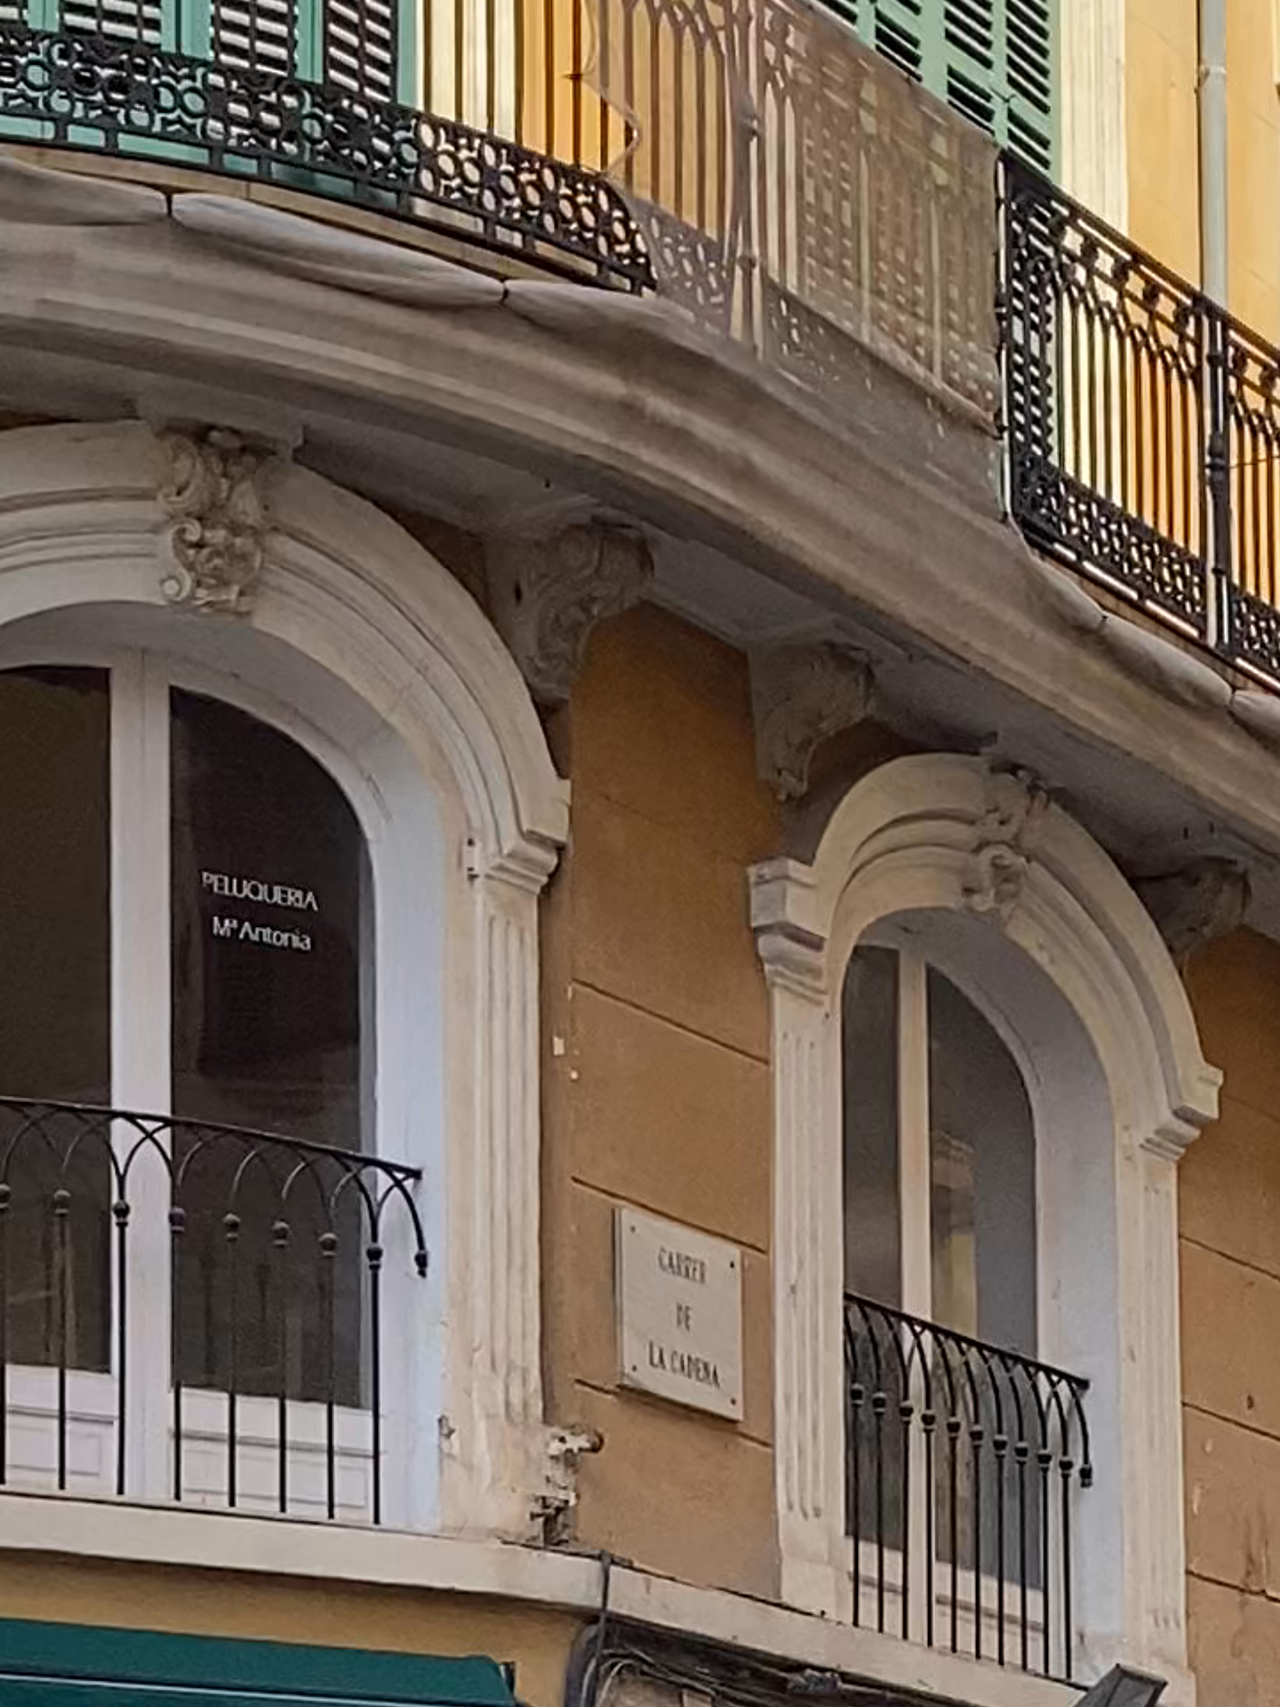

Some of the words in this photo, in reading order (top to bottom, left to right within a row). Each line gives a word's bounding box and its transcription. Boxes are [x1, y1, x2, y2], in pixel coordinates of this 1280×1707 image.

[201, 870, 319, 911] PELUQUERIA
[239, 921, 312, 951] Antonia
[657, 1246, 706, 1284] CARRER
[676, 1303, 692, 1332] DE
[648, 1340, 667, 1370] LA
[671, 1349, 720, 1389] CADENA
